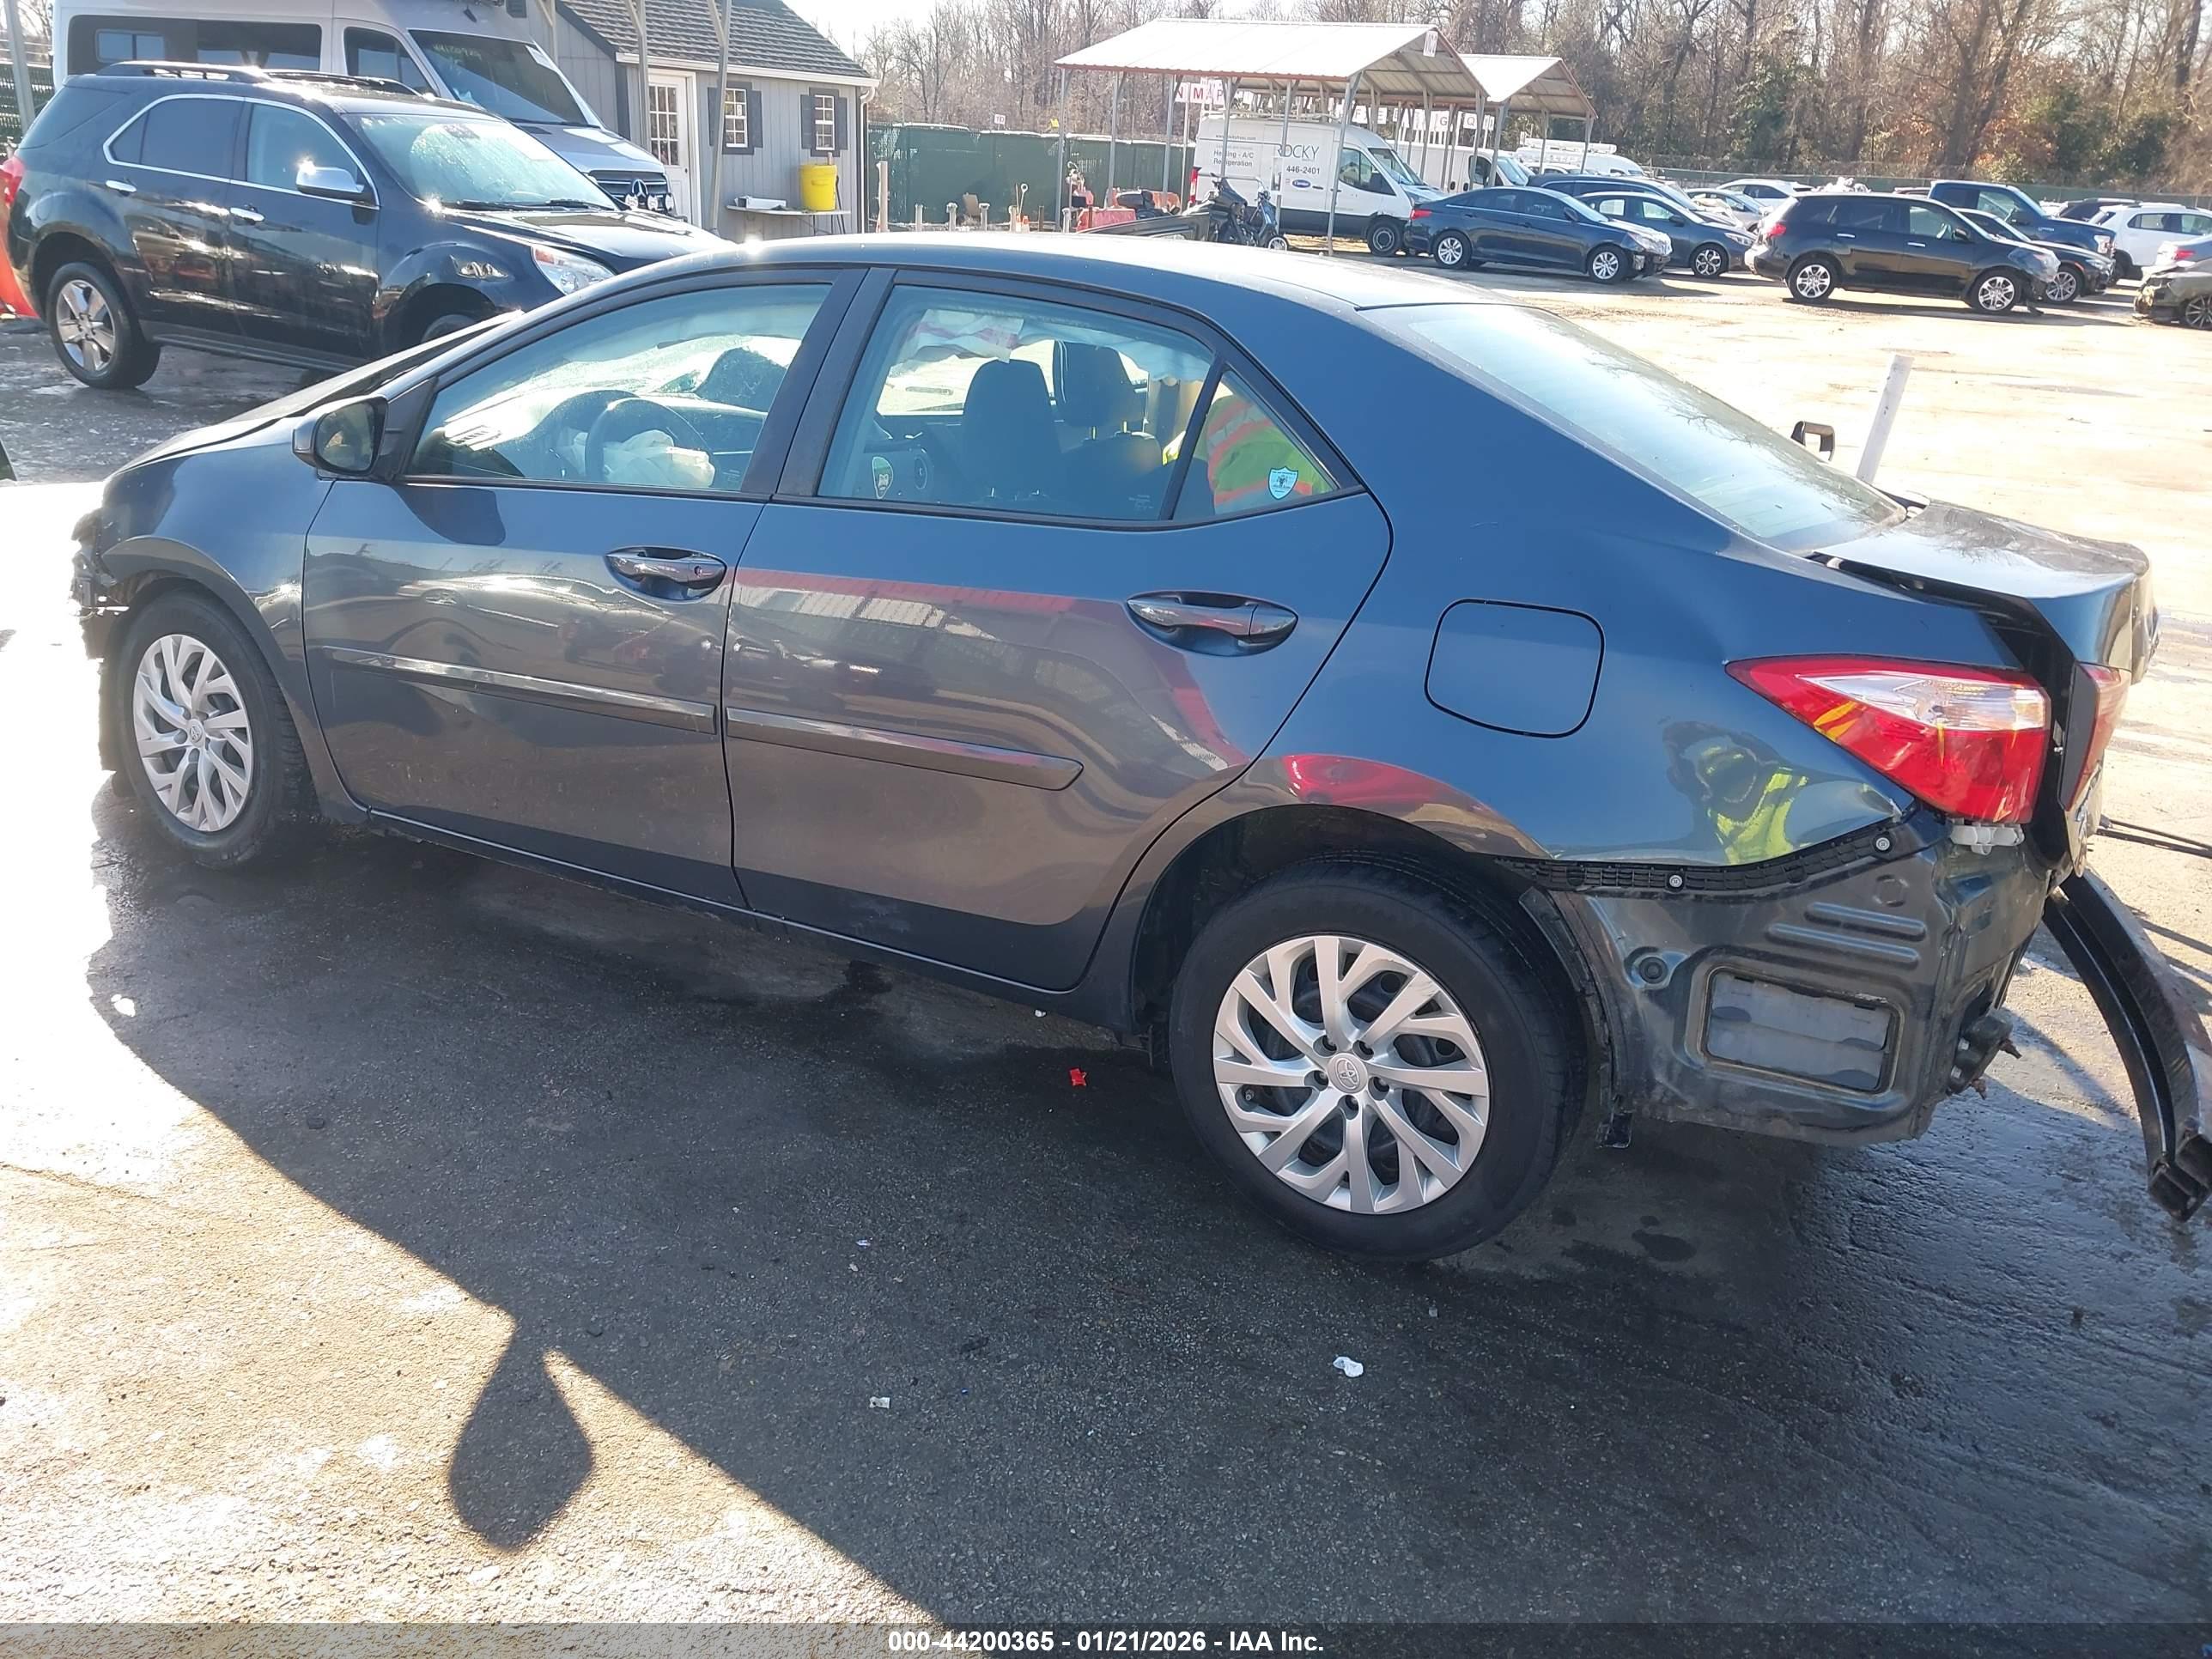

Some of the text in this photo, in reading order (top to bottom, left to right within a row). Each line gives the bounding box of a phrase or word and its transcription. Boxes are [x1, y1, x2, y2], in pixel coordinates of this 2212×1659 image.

[1194, 87, 1204, 100] M
[1217, 89, 1224, 100] P
[1439, 116, 1448, 126] G
[1467, 116, 1475, 126] Q
[1286, 166, 1321, 175] 446-2401
